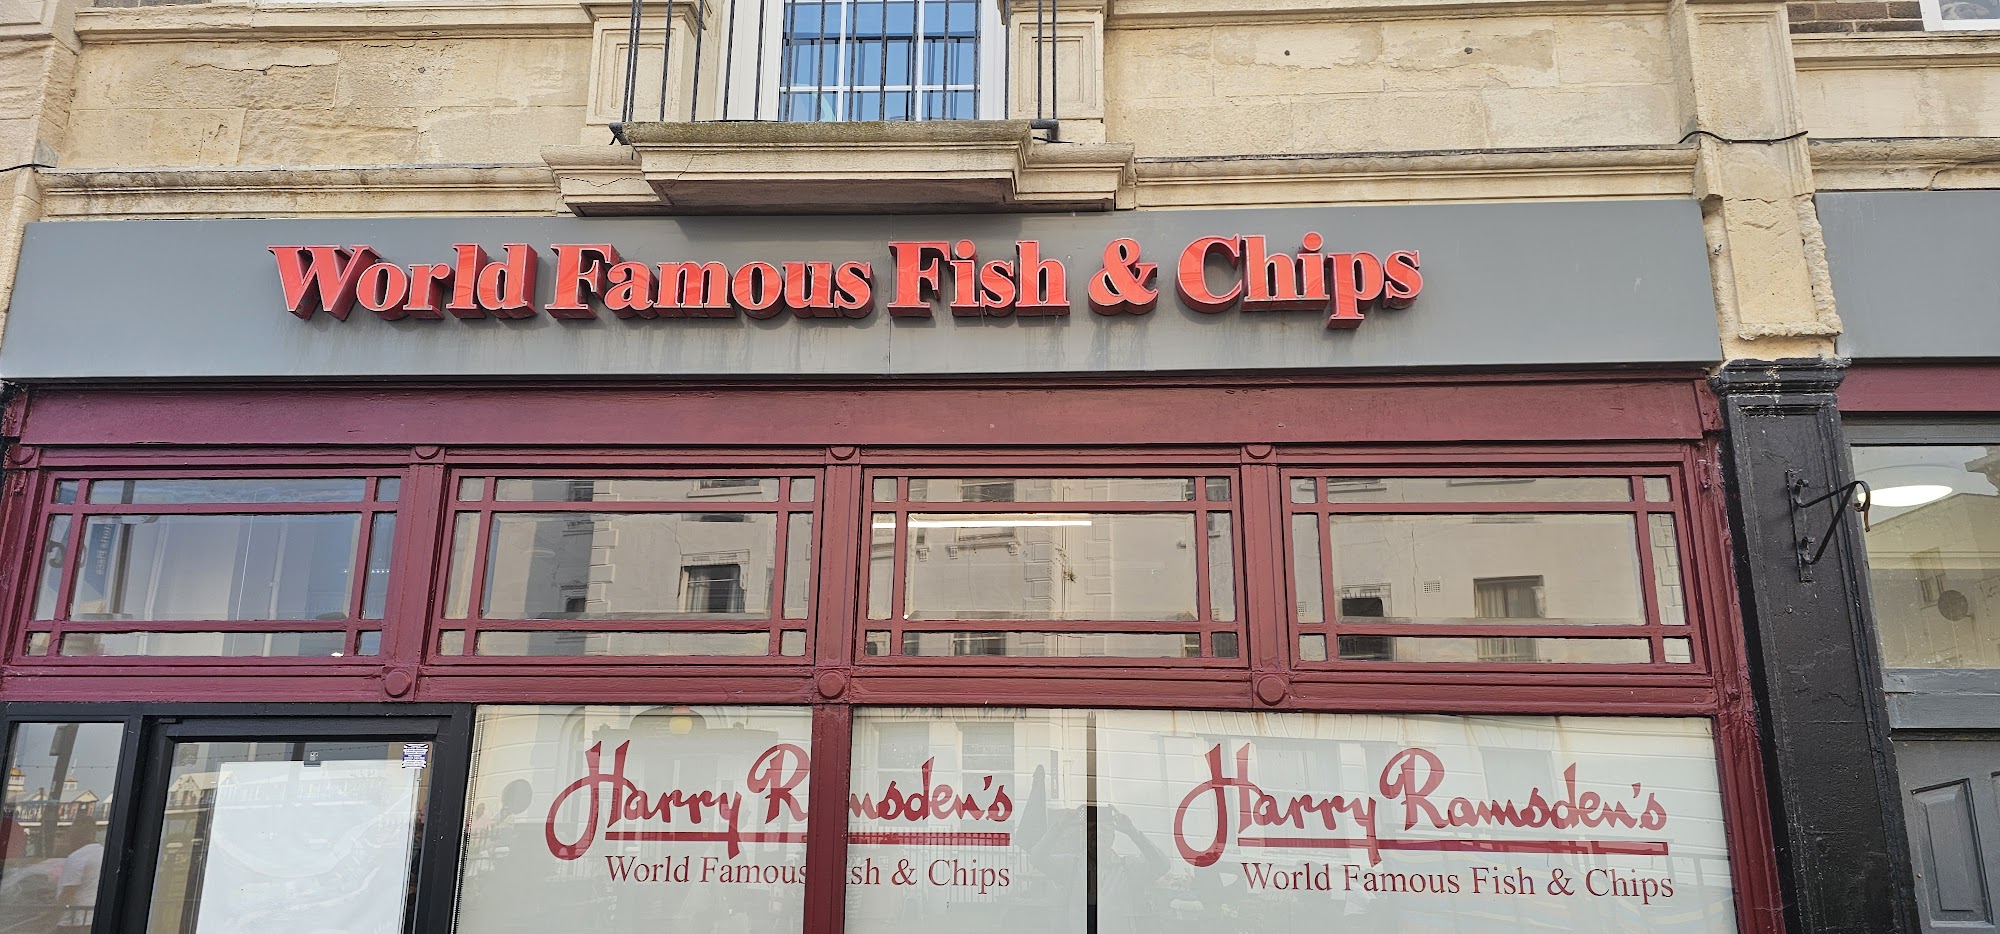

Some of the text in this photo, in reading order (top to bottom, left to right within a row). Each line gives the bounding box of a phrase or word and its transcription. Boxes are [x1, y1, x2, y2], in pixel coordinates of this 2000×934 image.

[267, 231, 1423, 330] World Famous Fish & Chips
[545, 740, 1013, 860] Harry Rmsden's
[1174, 742, 1668, 867] Harry Ramsden's
[605, 855, 690, 882] World
[891, 859, 918, 886] &
[928, 859, 1010, 894] Chips
[1241, 862, 1674, 905] World Famous Fish & Chips
